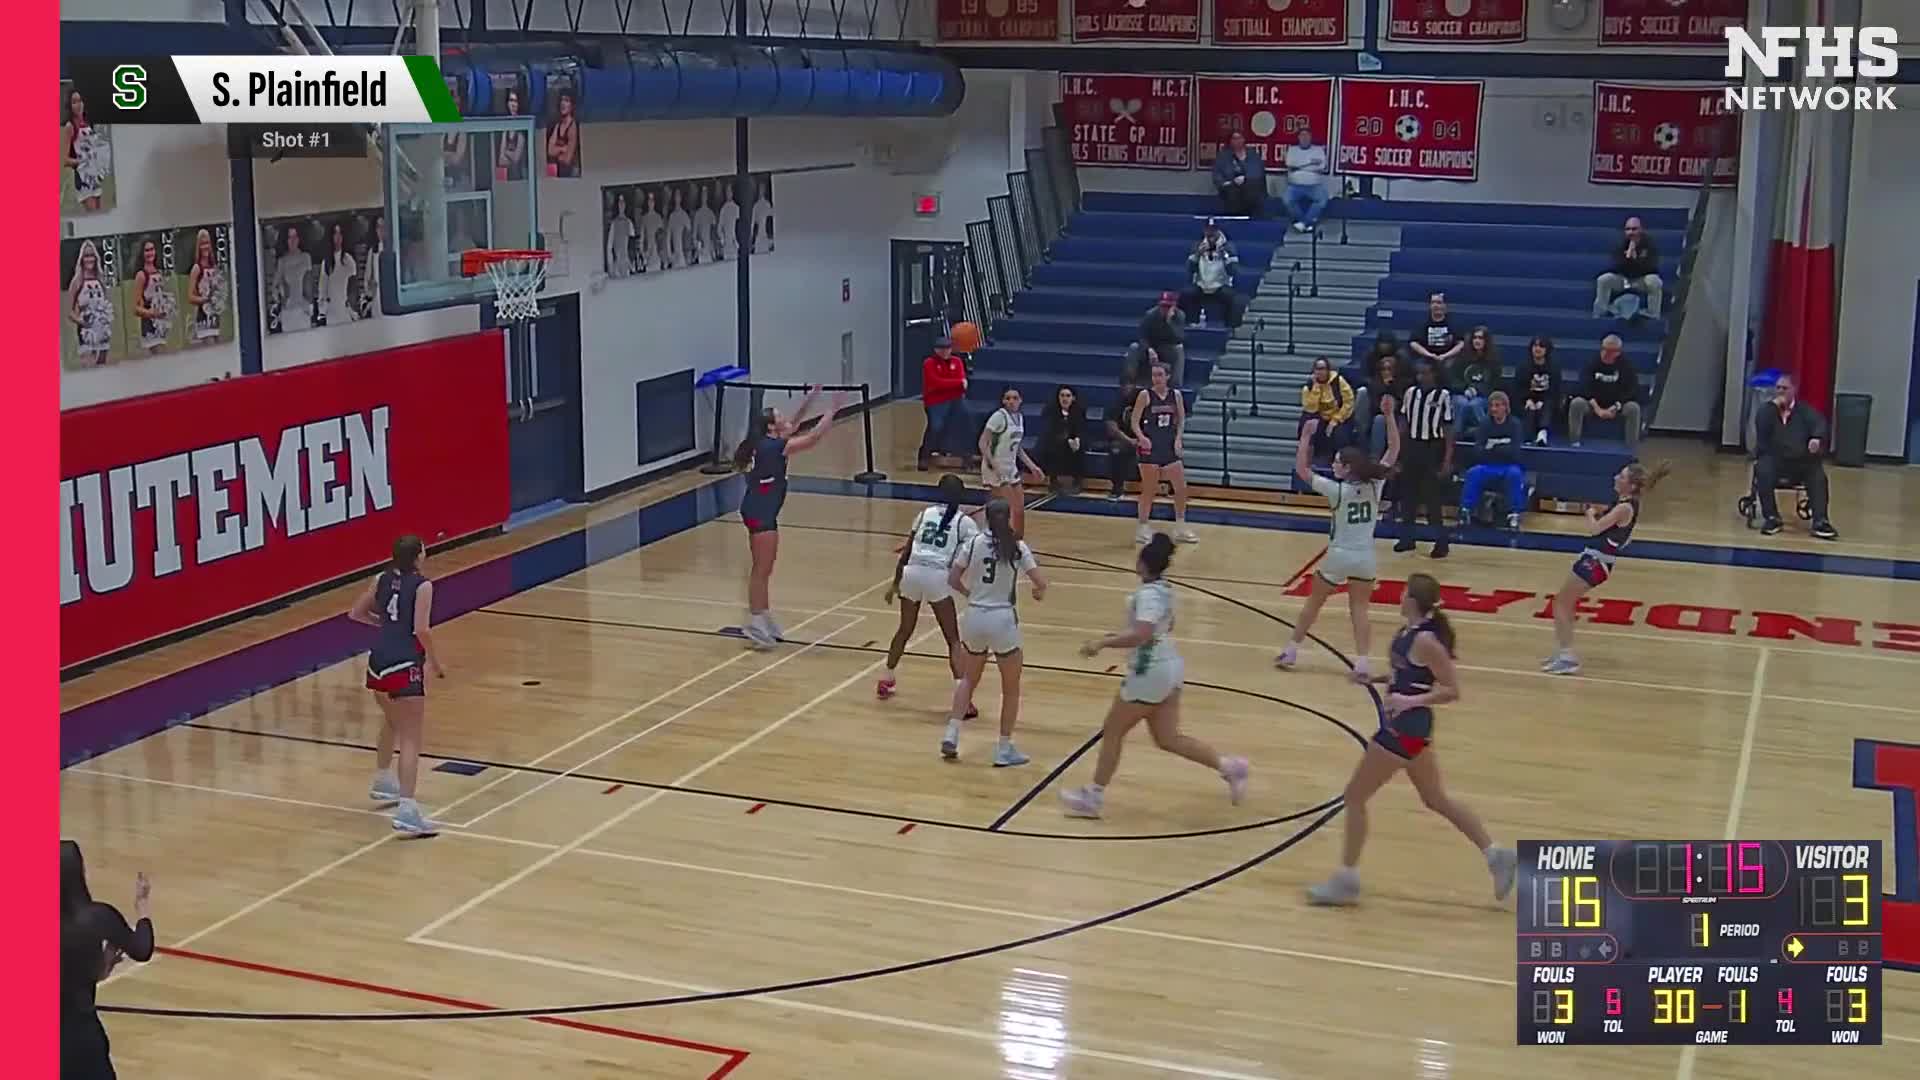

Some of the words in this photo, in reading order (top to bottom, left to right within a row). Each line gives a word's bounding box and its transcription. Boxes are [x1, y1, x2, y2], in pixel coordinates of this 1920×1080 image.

[1149, 15, 1196, 32] CHAMPIONS
[1224, 17, 1271, 36] SOFTBALL
[1282, 17, 1336, 36] CHAMPIONS
[1426, 21, 1462, 35] SOCCER
[1640, 16, 1680, 35] SOCCER
[1152, 80, 1189, 97] M.C.T.
[1245, 86, 1284, 105] I.H.C.
[1388, 88, 1430, 109] I.H.C.
[1074, 124, 1117, 143] STATE
[1129, 126, 1146, 144] GP
[1160, 127, 1176, 145] III
[1355, 115, 1383, 137] 20
[1432, 119, 1462, 141] 04
[1096, 144, 1129, 162] TENNIS
[1136, 146, 1187, 165] CHAMPIONS
[1340, 144, 1367, 163] GIRLS
[1375, 147, 1413, 167] SOCCER
[1419, 149, 1474, 169] CHAMPIONS
[1594, 153, 1624, 173] GIRLS
[1631, 155, 1671, 176] SOCCER
[1347, 501, 1371, 524] 20
[982, 557, 997, 584] 3
[386, 593, 400, 622] 4
